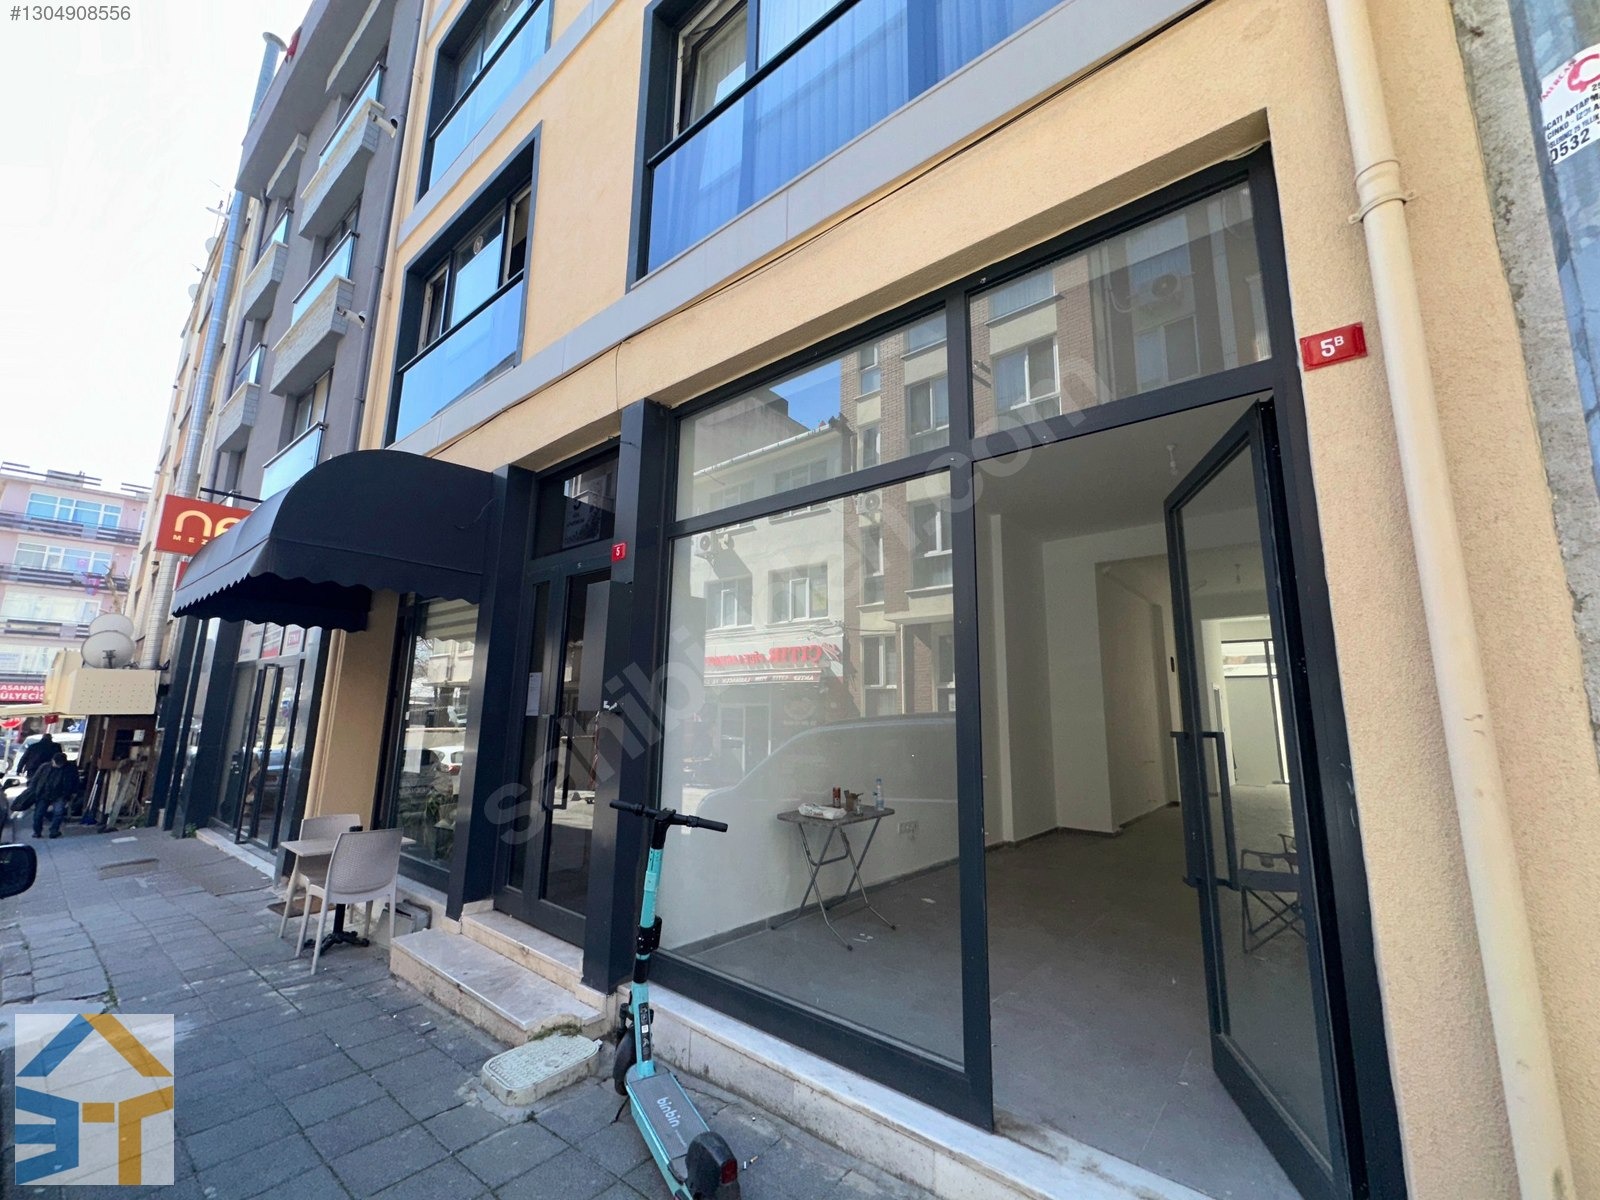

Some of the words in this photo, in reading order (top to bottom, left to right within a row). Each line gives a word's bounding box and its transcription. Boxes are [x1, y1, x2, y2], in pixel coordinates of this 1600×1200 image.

[174, 510, 241, 538] ne
[172, 534, 209, 546] MEZ
[0, 684, 45, 694] ASANPAŞ
[657, 1097, 680, 1127] binbin
